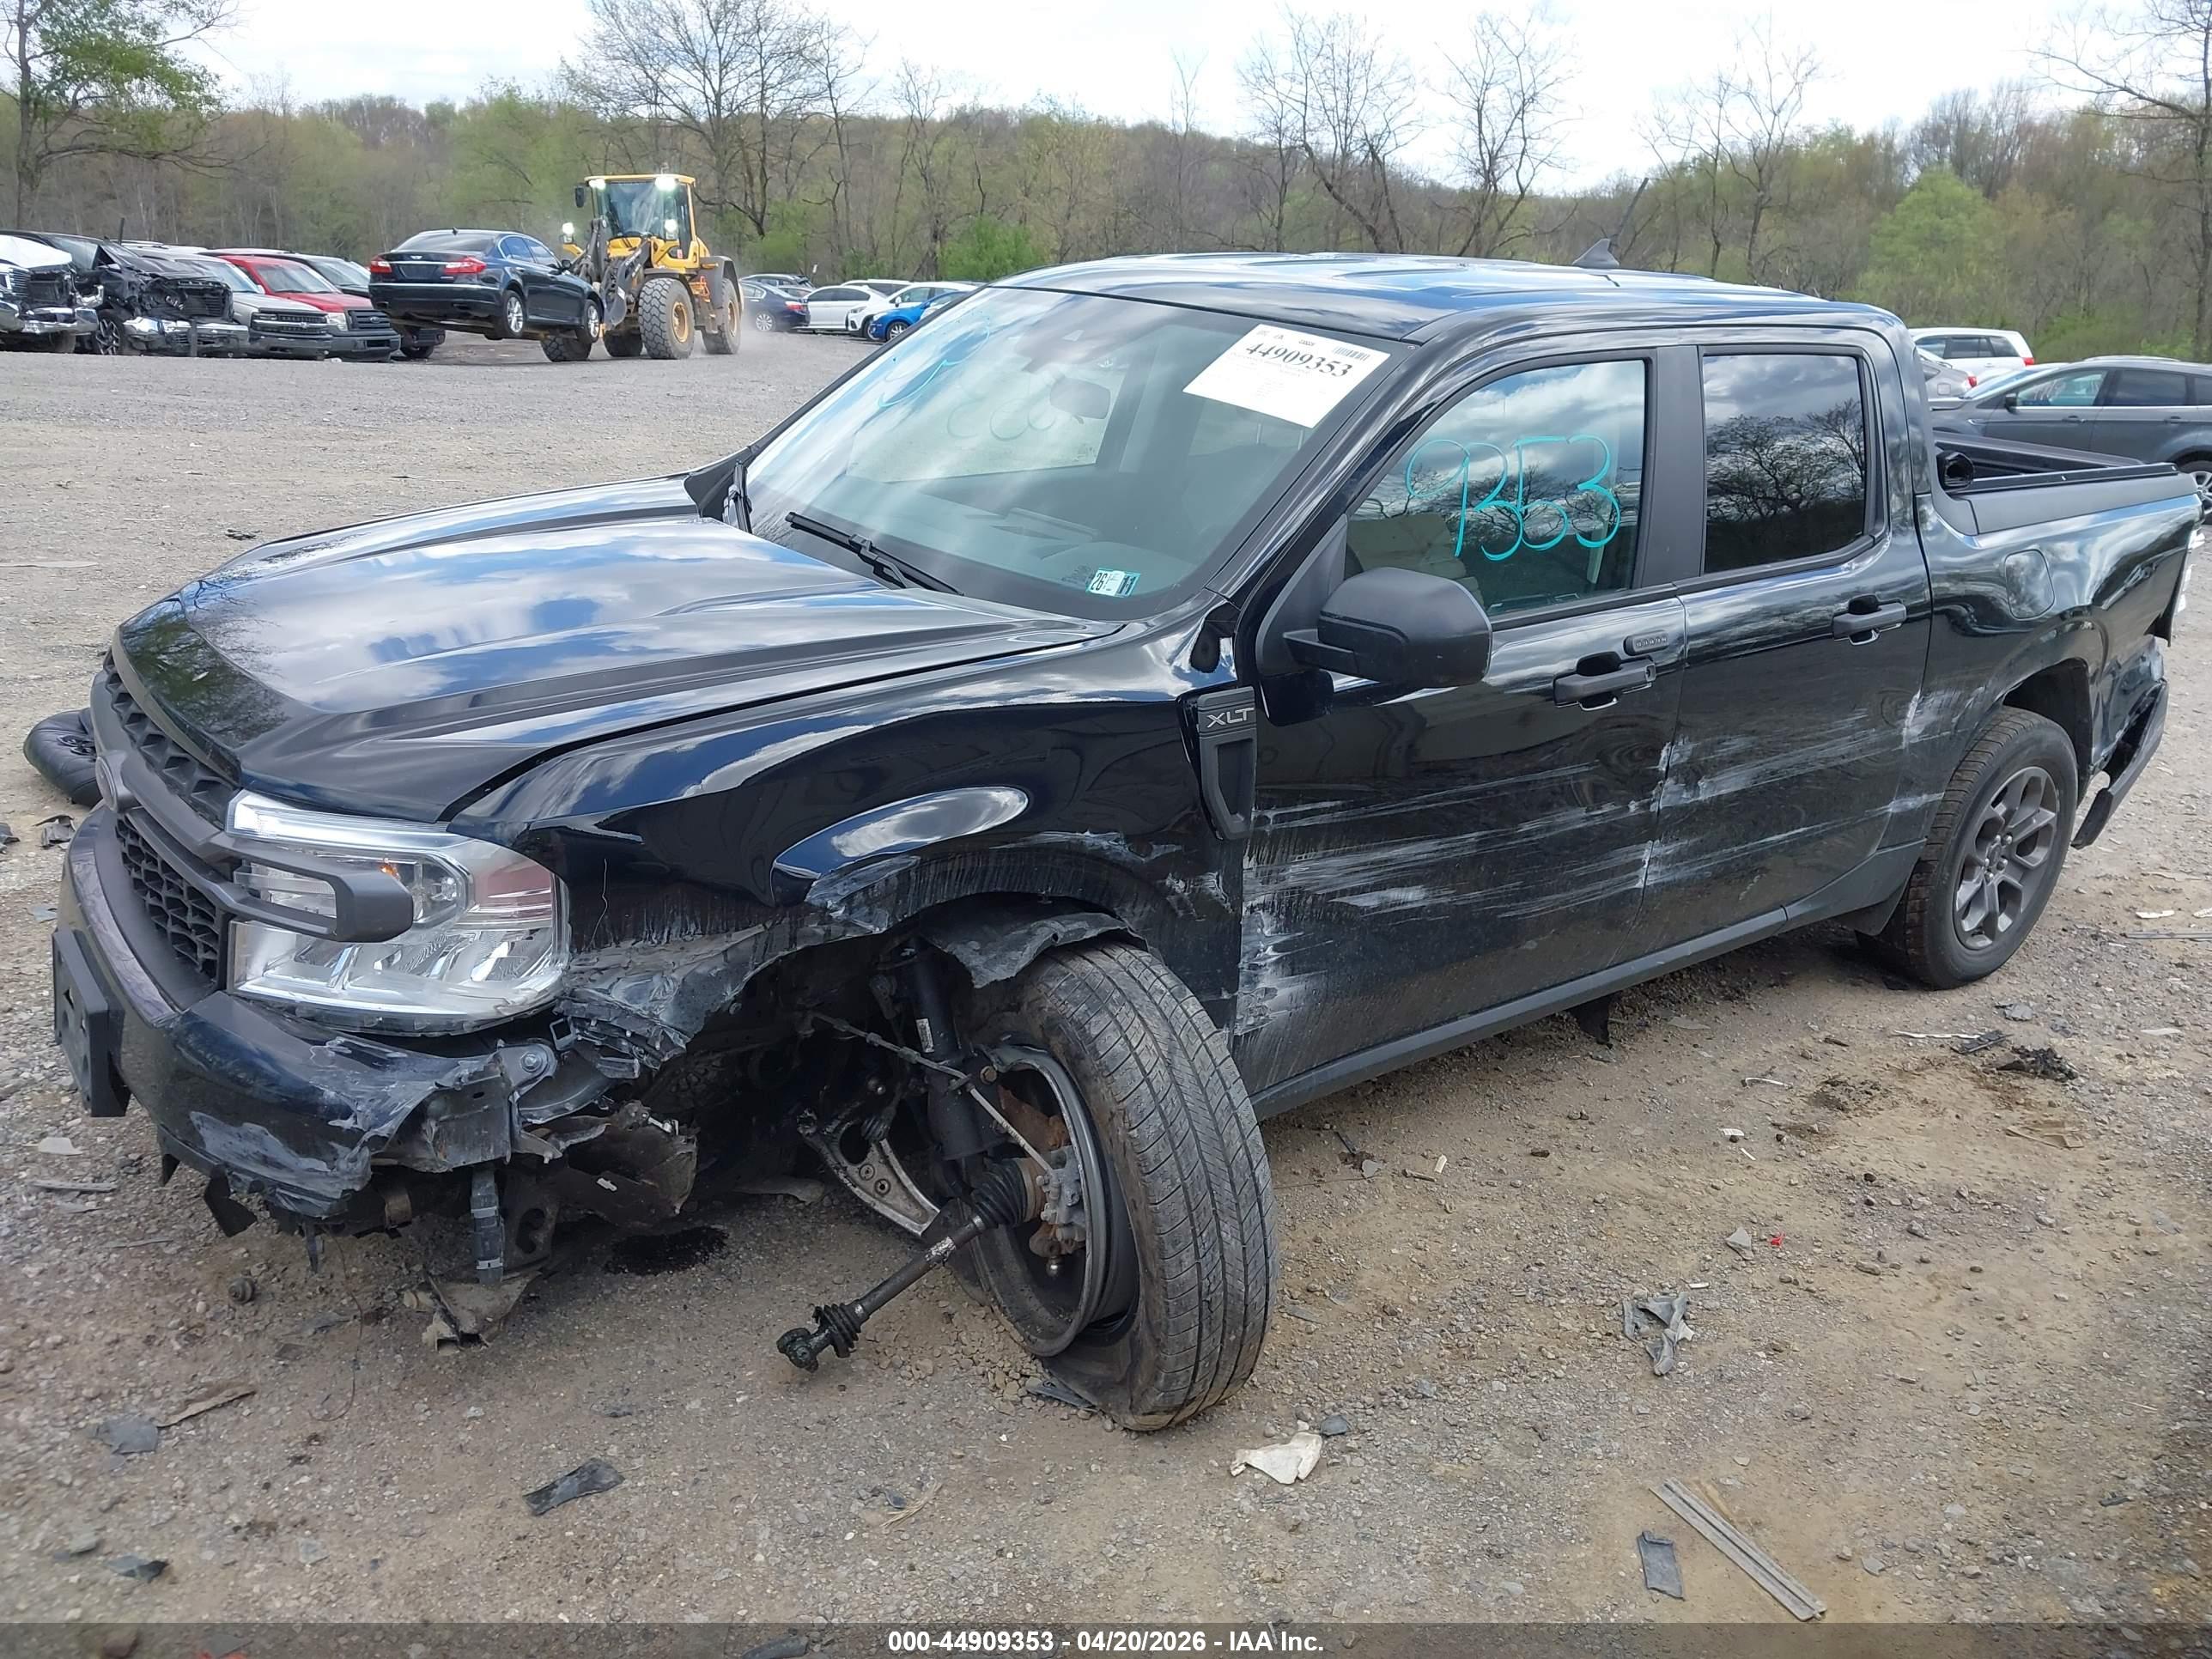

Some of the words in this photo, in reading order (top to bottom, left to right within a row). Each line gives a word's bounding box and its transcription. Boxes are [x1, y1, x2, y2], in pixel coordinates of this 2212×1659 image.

[1245, 343, 1353, 378] 44909353
[1090, 572, 1109, 592] 26
[1206, 707, 1255, 728] XLT
